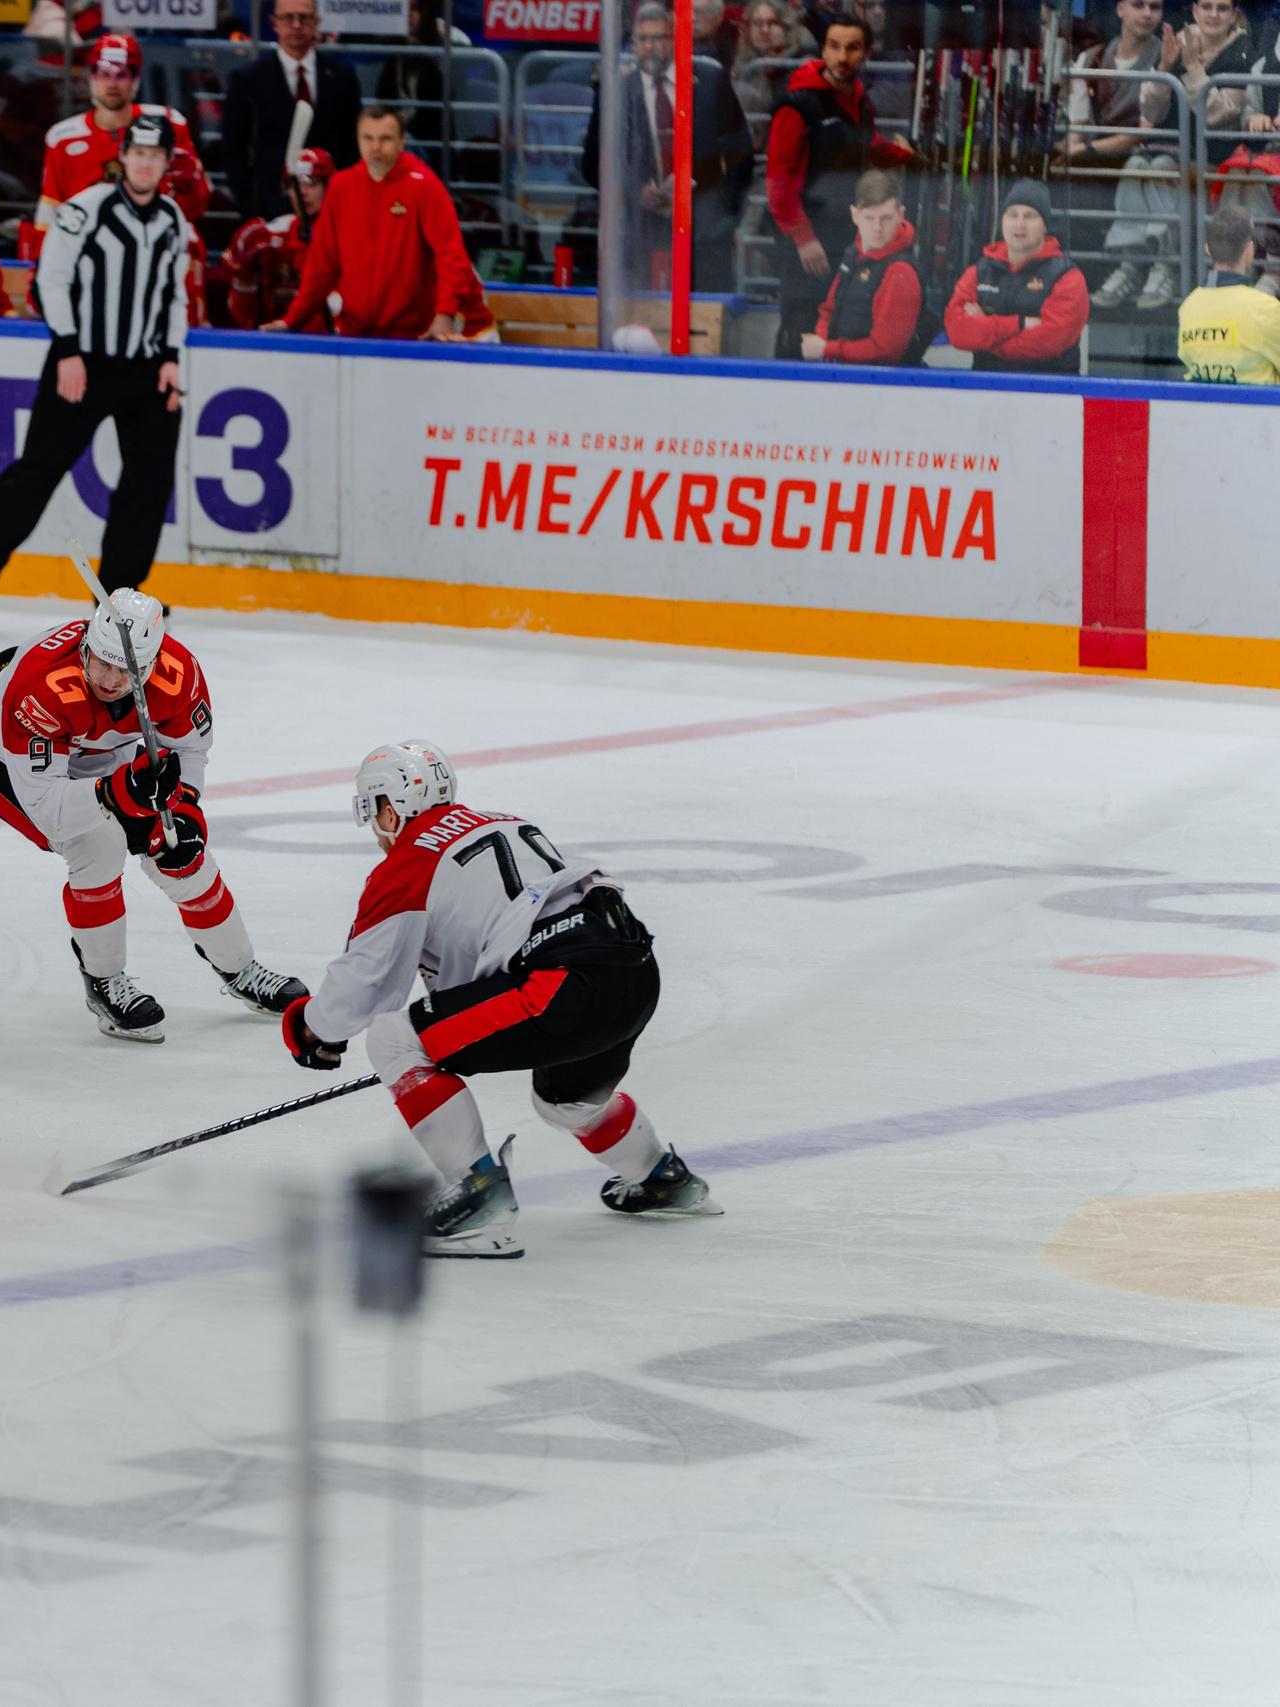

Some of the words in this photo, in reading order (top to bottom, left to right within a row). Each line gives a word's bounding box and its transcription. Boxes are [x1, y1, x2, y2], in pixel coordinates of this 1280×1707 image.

[487, 1, 601, 31] FONBET
[1181, 327, 1230, 344] SAFETY
[426, 426, 454, 443] МЫ
[466, 427, 538, 447] ВСЕГДА
[547, 433, 571, 448] НА
[581, 435, 645, 452] СВЯЗИ
[655, 439, 834, 465] #REDSTARHOCKEY
[843, 450, 1001, 473] #UNITEDWEWIN
[424, 456, 997, 562] T.ME/KRSCHINA
[190, 699, 213, 738] 9
[28, 736, 53, 774] 9
[428, 762, 450, 782] 70
[451, 824, 568, 903] 70
